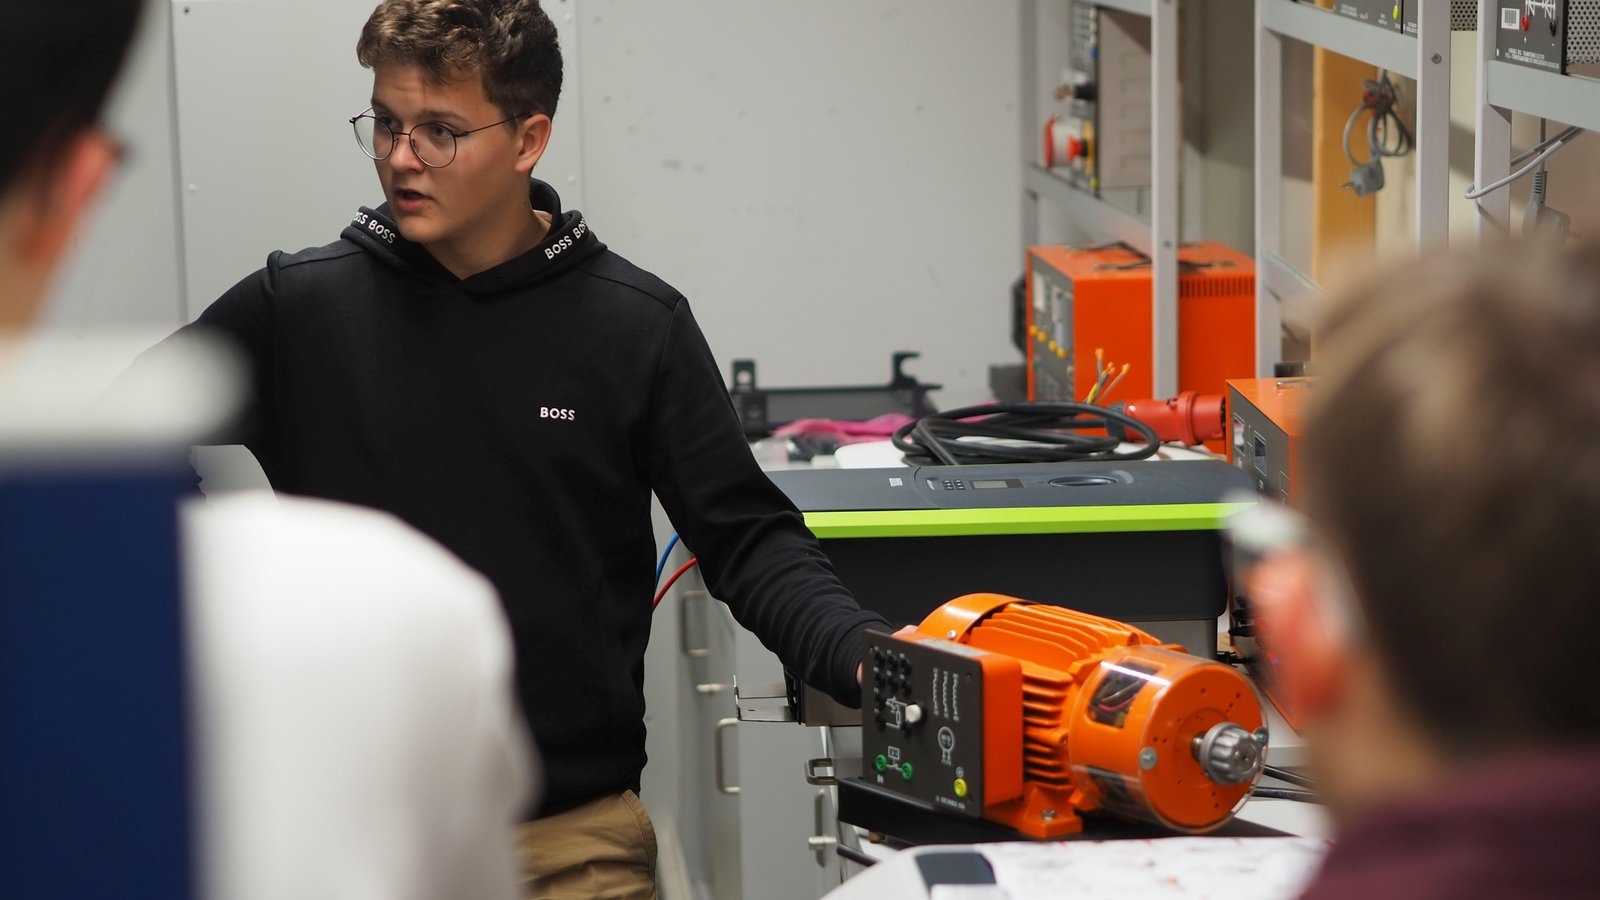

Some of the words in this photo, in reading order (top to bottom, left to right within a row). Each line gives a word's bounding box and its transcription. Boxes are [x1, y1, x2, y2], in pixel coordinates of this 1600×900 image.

[368, 219, 396, 244] BOSS
[544, 235, 573, 260] BOSS
[539, 406, 575, 421] BOSS
